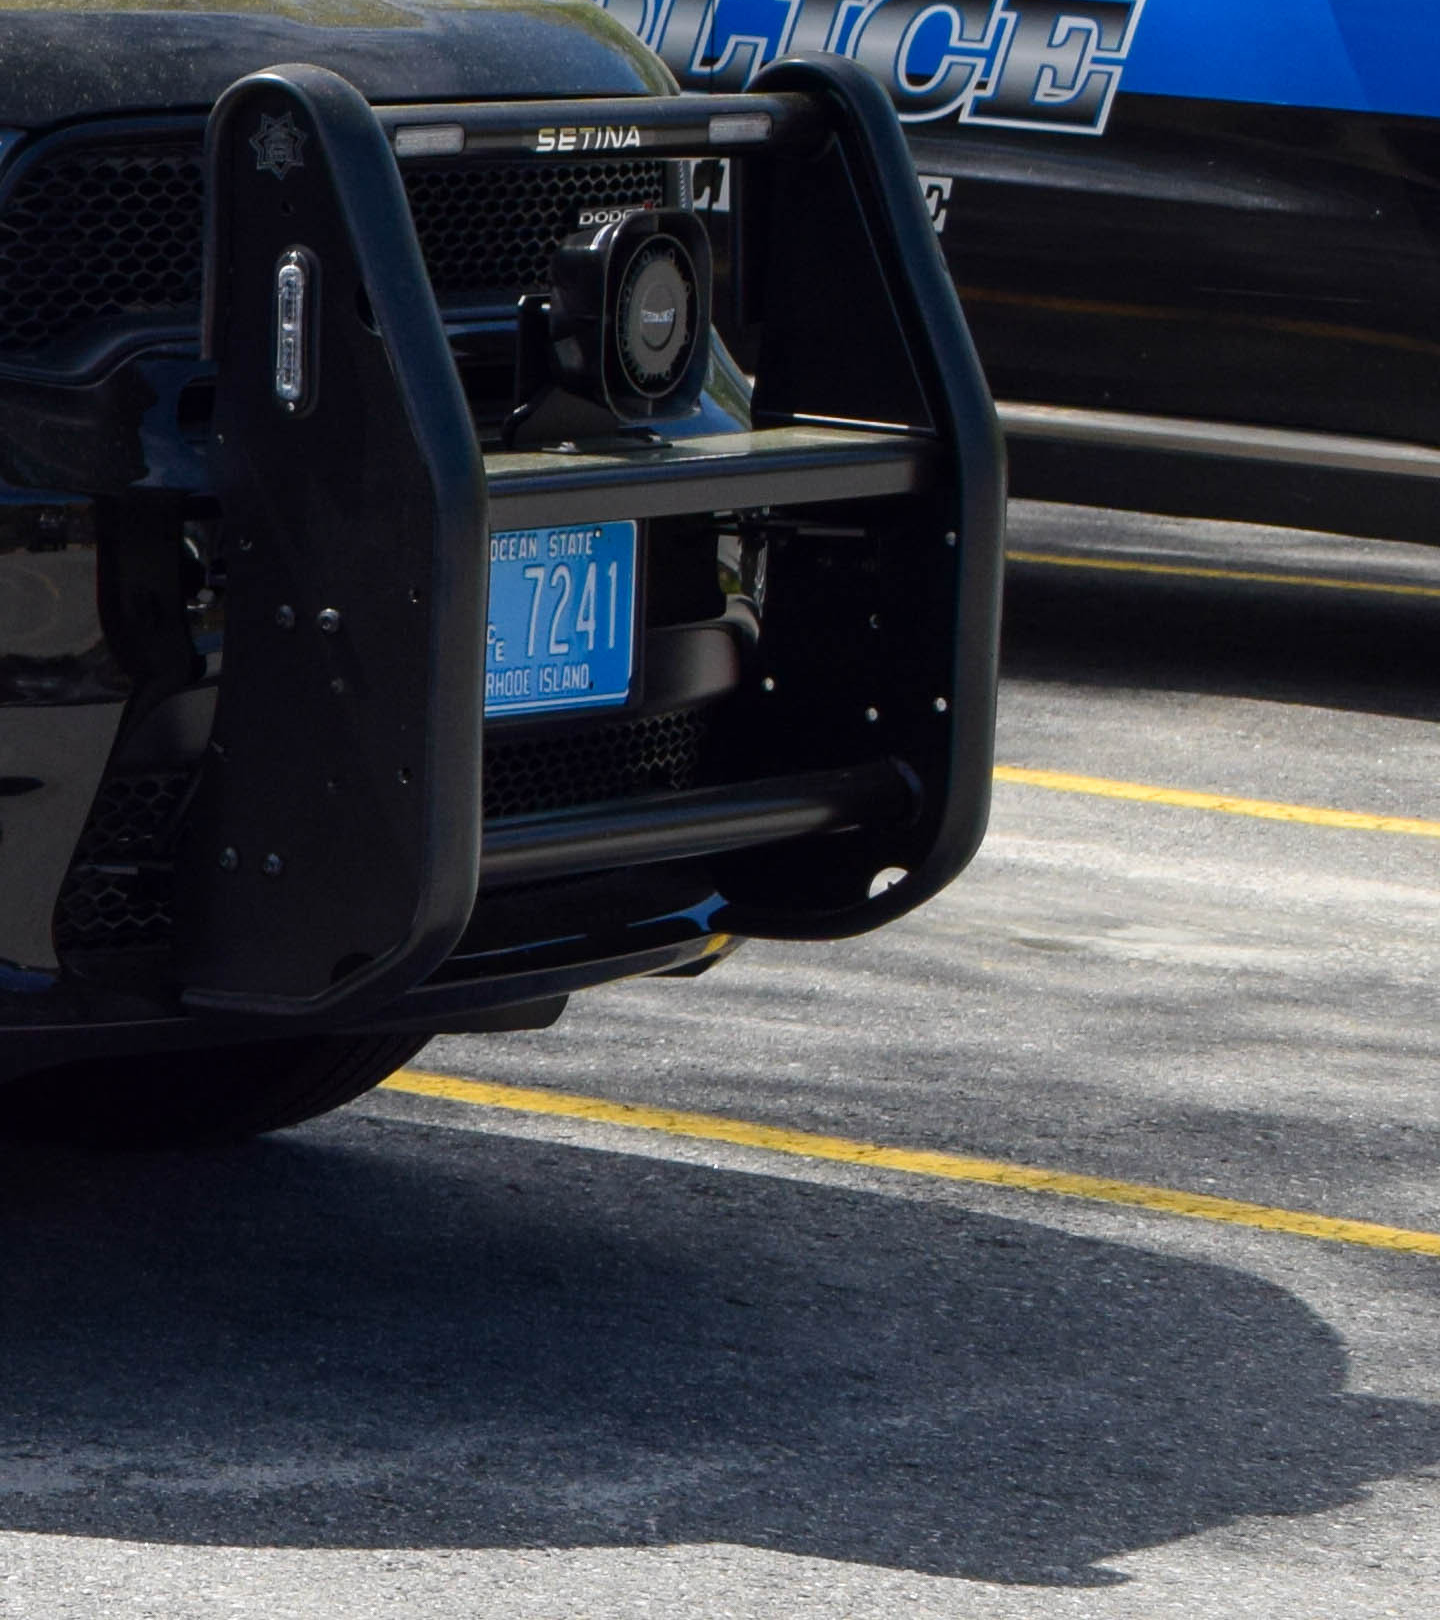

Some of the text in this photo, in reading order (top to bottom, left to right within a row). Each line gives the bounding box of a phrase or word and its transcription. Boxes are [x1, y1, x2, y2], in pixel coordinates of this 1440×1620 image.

[535, 125, 641, 152] SETINA
[490, 531, 593, 563] OCEAN STATE
[523, 559, 618, 658] 7241
[485, 662, 589, 698] RHODE ISLAND
